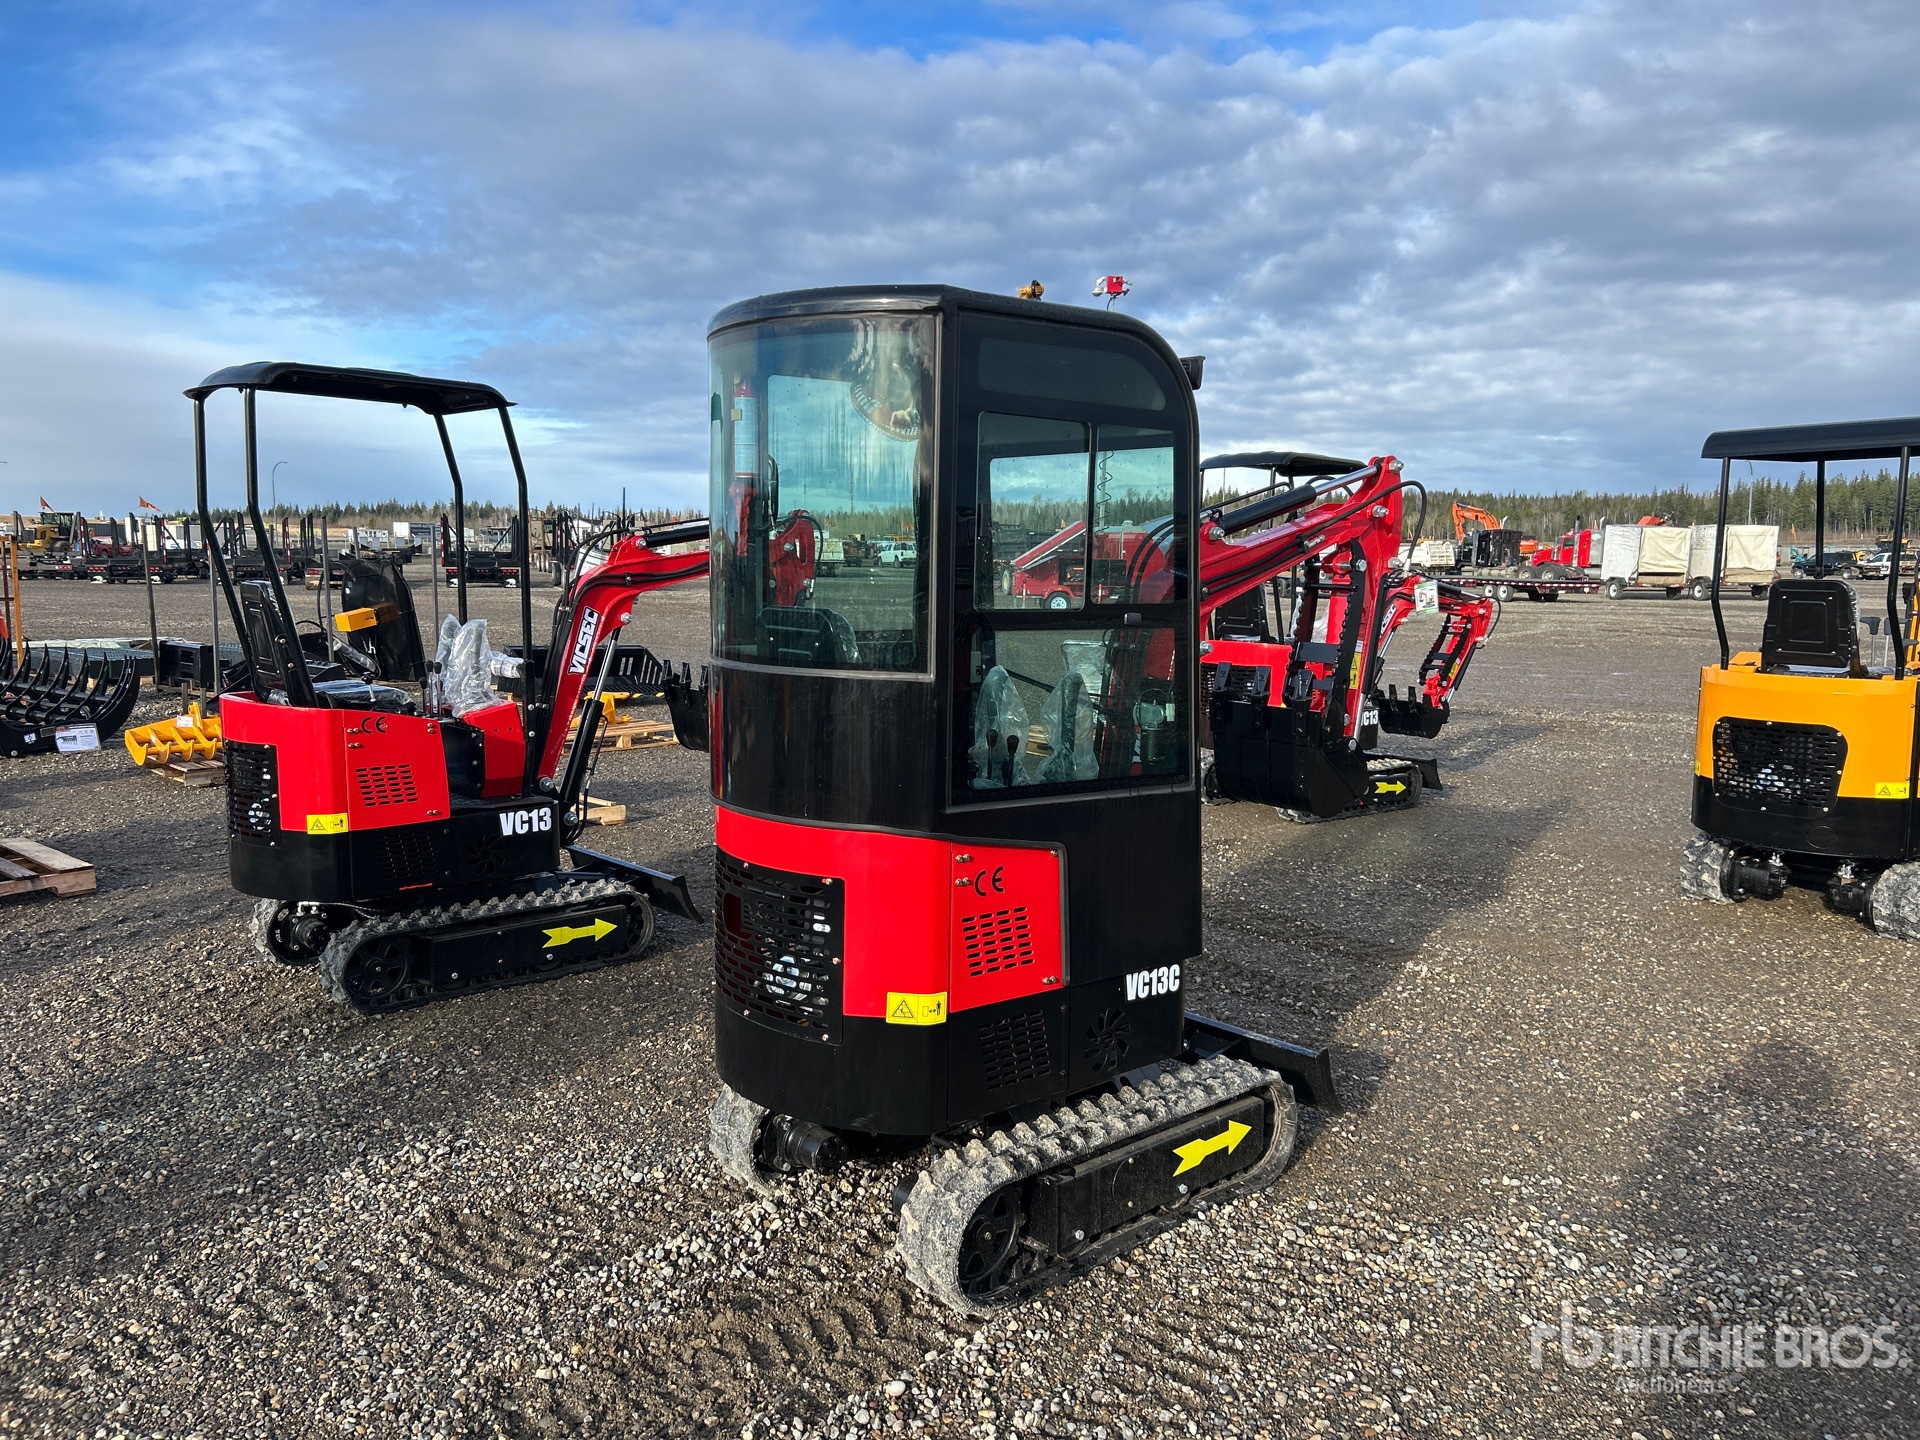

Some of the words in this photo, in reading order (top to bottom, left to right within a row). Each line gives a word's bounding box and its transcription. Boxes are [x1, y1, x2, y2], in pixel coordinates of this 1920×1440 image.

[569, 608, 599, 674] VICSEC
[361, 715, 387, 734] CE
[1361, 710, 1379, 726] C13
[499, 807, 552, 836] VC13
[974, 865, 1004, 897] CE
[1126, 964, 1180, 1001] VC13C
